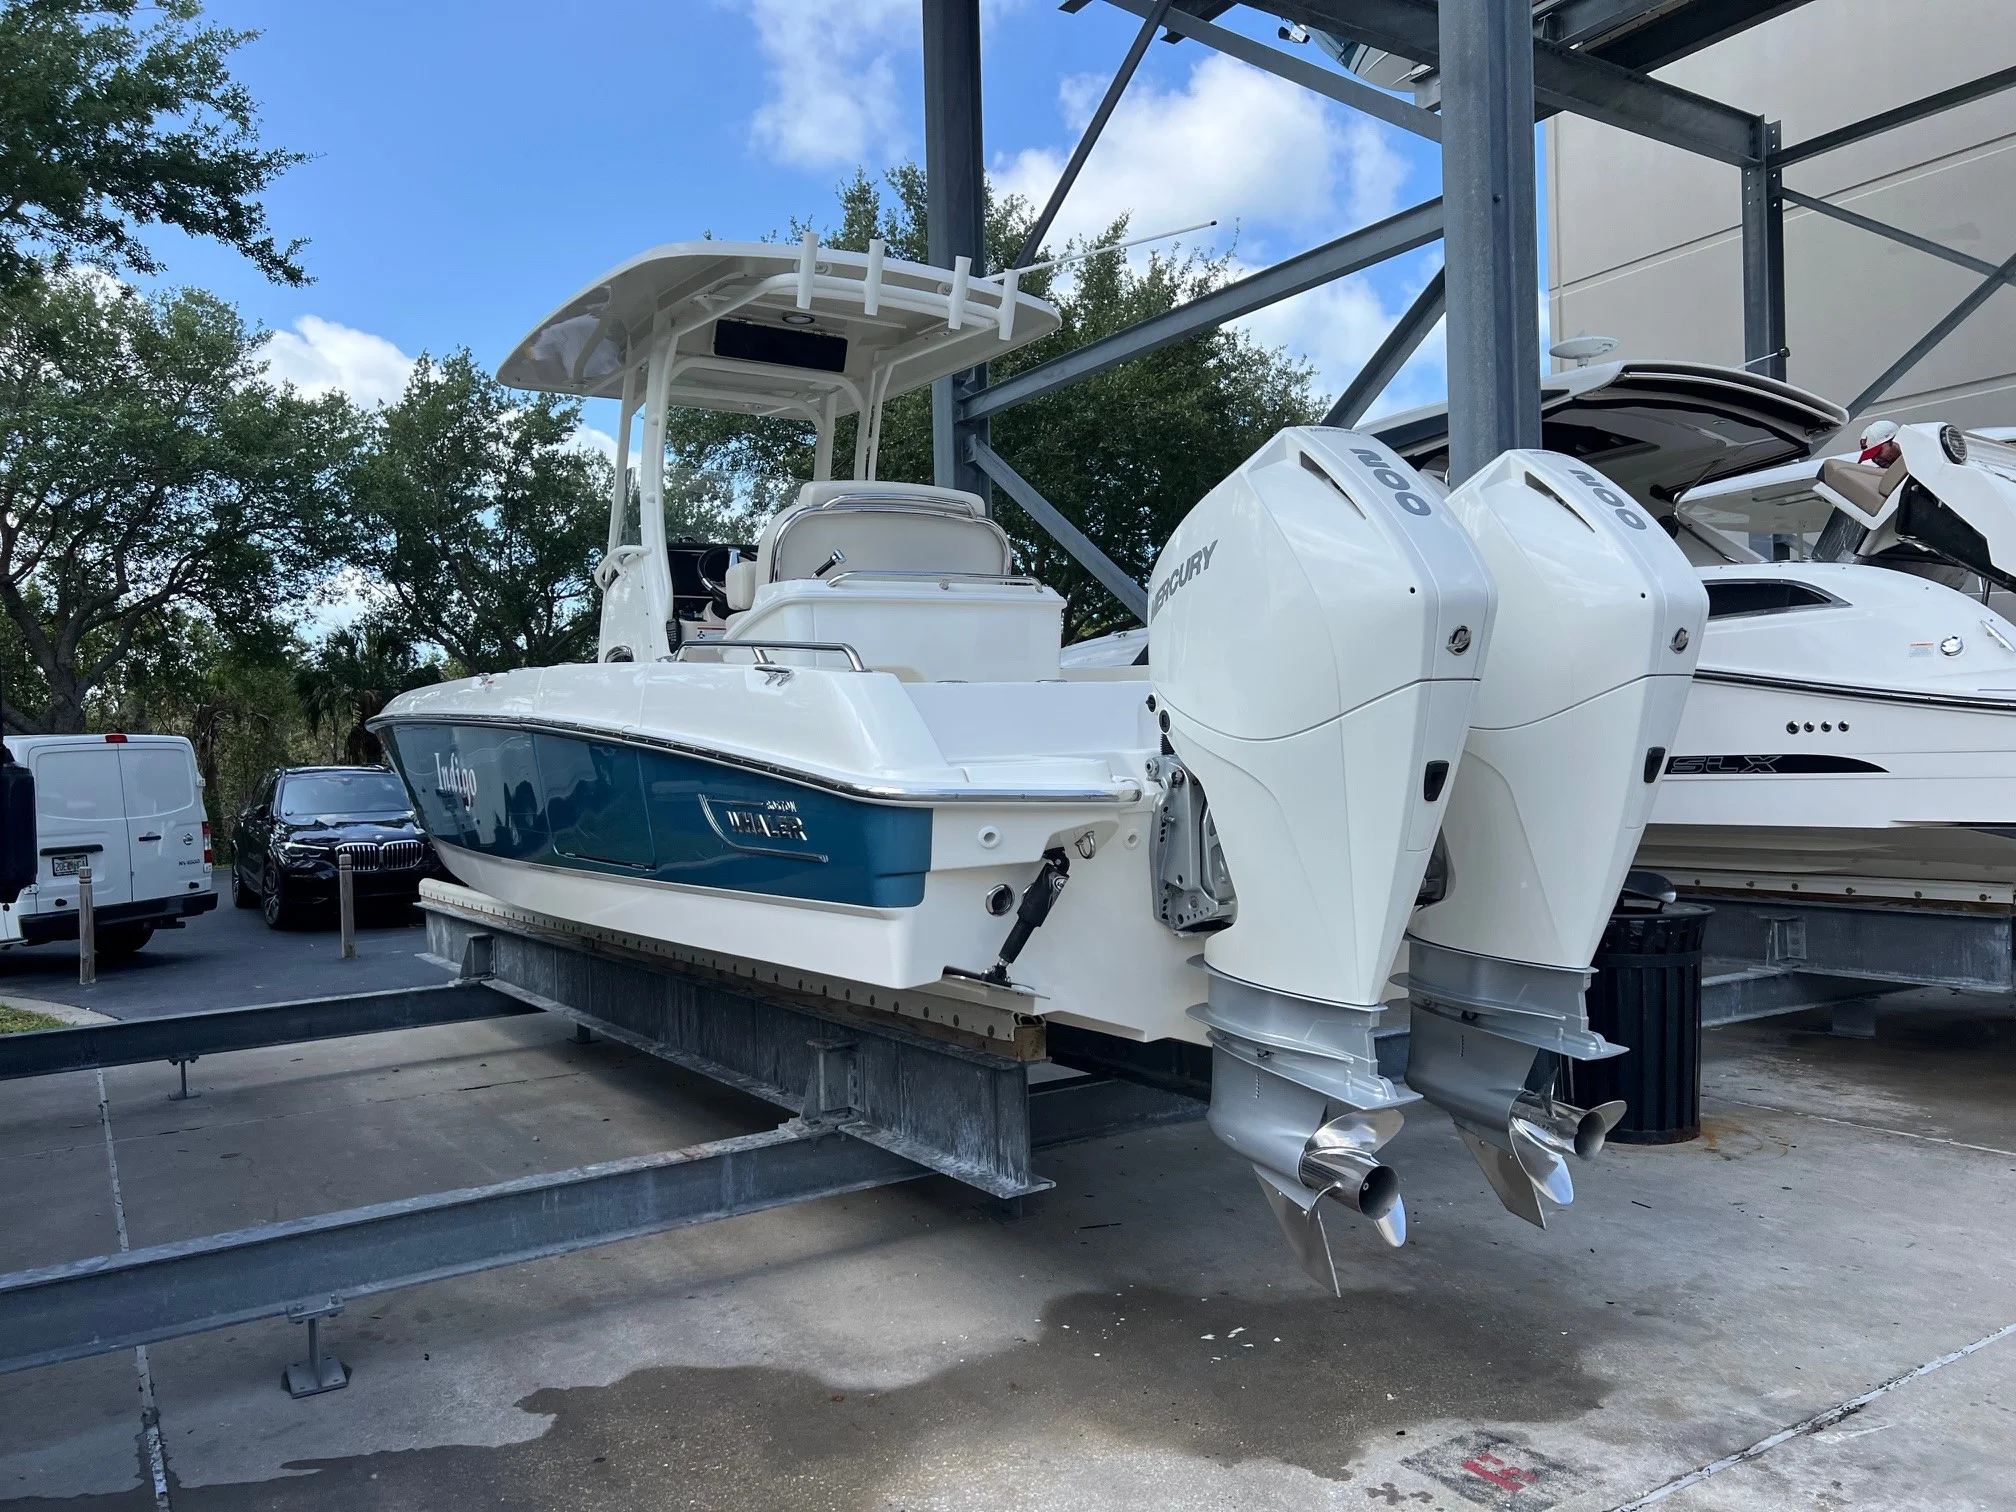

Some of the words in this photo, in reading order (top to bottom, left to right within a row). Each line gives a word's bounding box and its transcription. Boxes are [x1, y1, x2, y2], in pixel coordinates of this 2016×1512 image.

[1670, 755, 1783, 774] SLX
[434, 752, 478, 812] Indigo
[726, 810, 808, 841] WHALER
